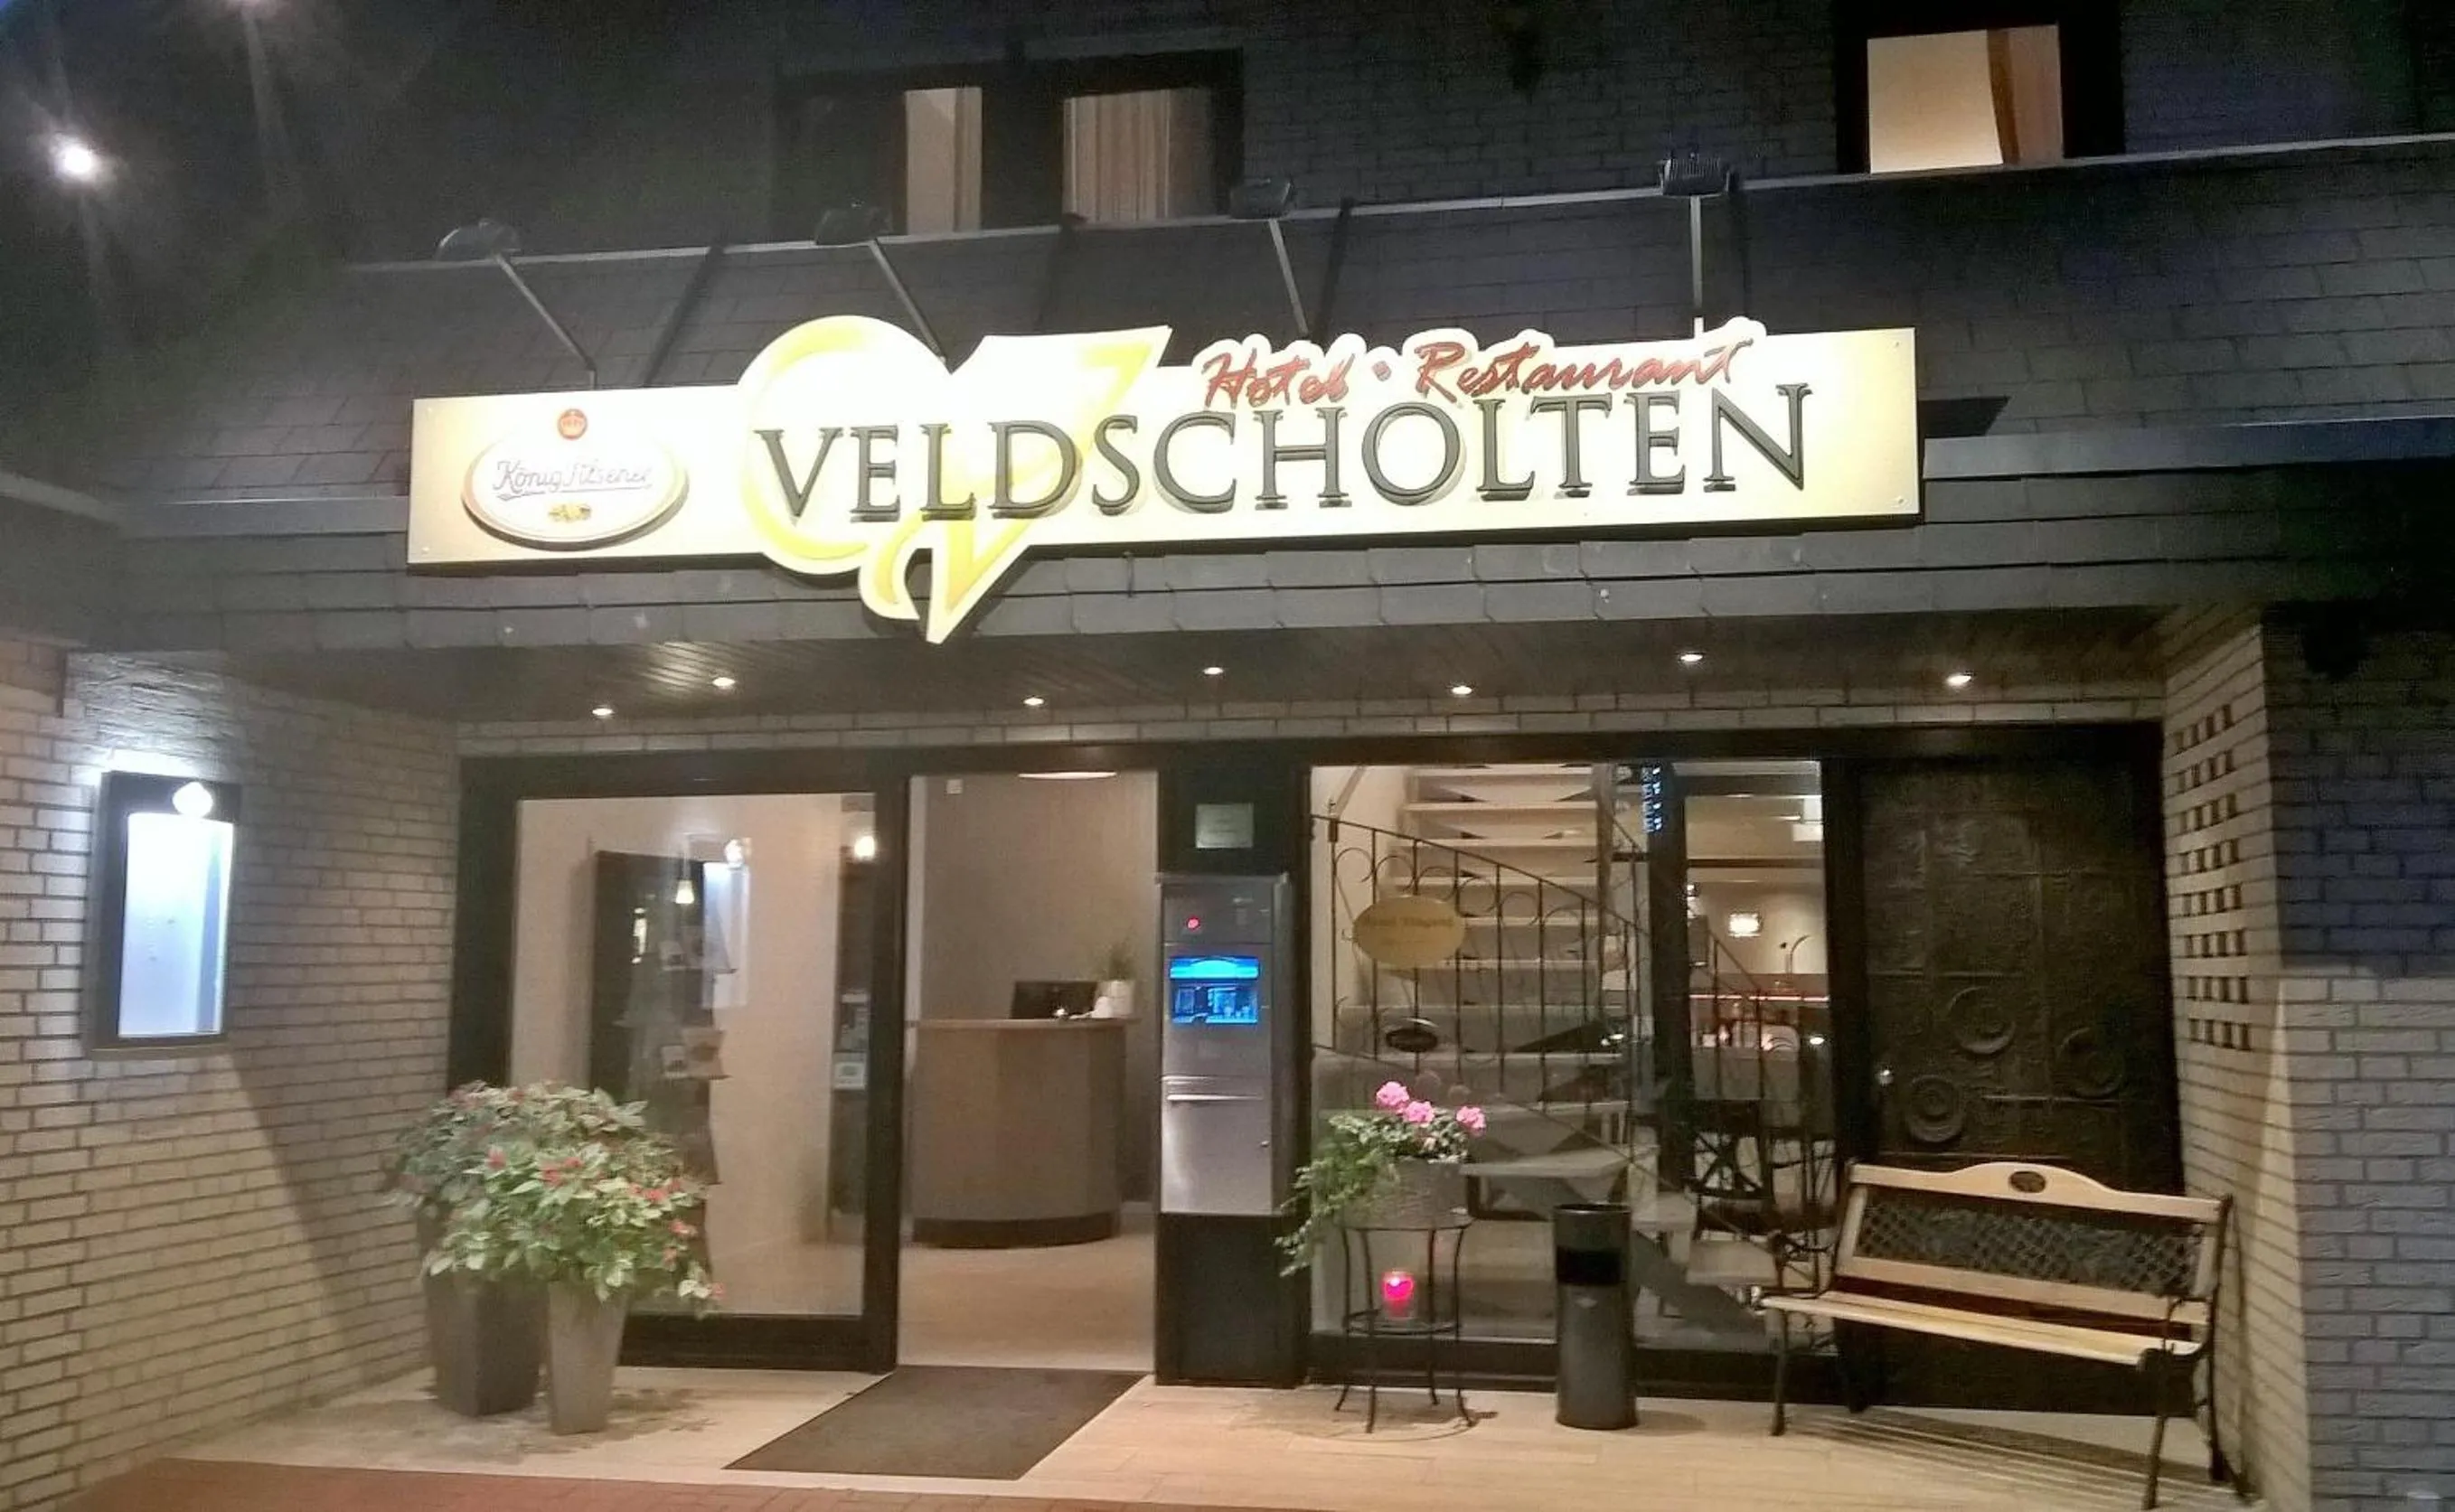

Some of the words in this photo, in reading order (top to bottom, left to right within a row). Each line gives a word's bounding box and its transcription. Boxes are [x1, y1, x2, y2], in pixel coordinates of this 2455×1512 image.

[1202, 349, 1357, 409] Hotel
[1414, 339, 1755, 403] Restaurant
[754, 383, 1811, 522] VELDSCHOLTEN
